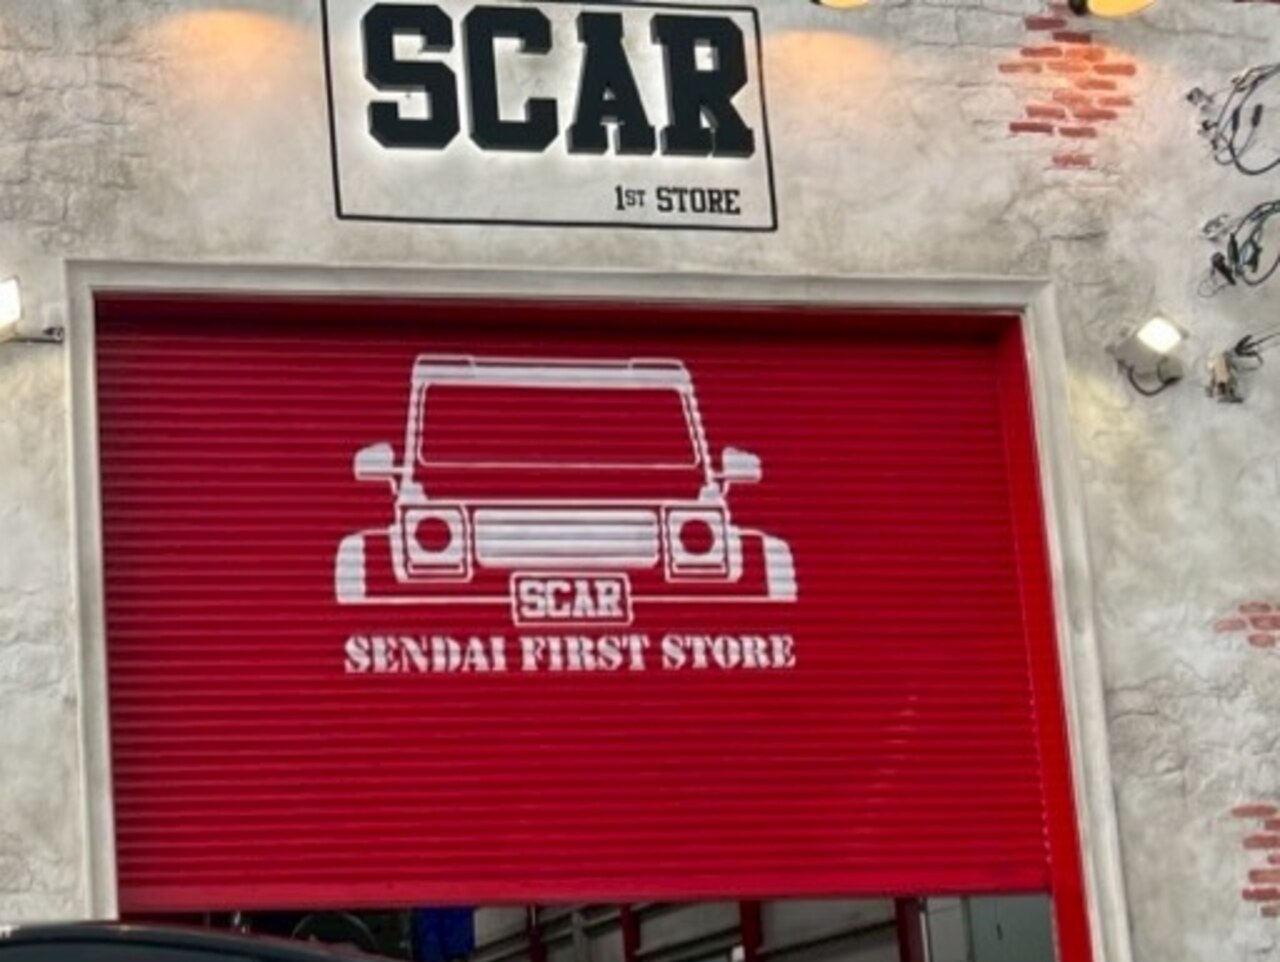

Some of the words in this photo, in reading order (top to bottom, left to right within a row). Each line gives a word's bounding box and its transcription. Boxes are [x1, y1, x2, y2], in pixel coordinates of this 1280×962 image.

[361, 2, 755, 158] SCAR
[656, 186, 741, 215] STORE
[519, 579, 625, 619] SCAR
[344, 635, 508, 673] SENDAI
[520, 635, 651, 671] FIRST
[661, 634, 796, 670] STORE
